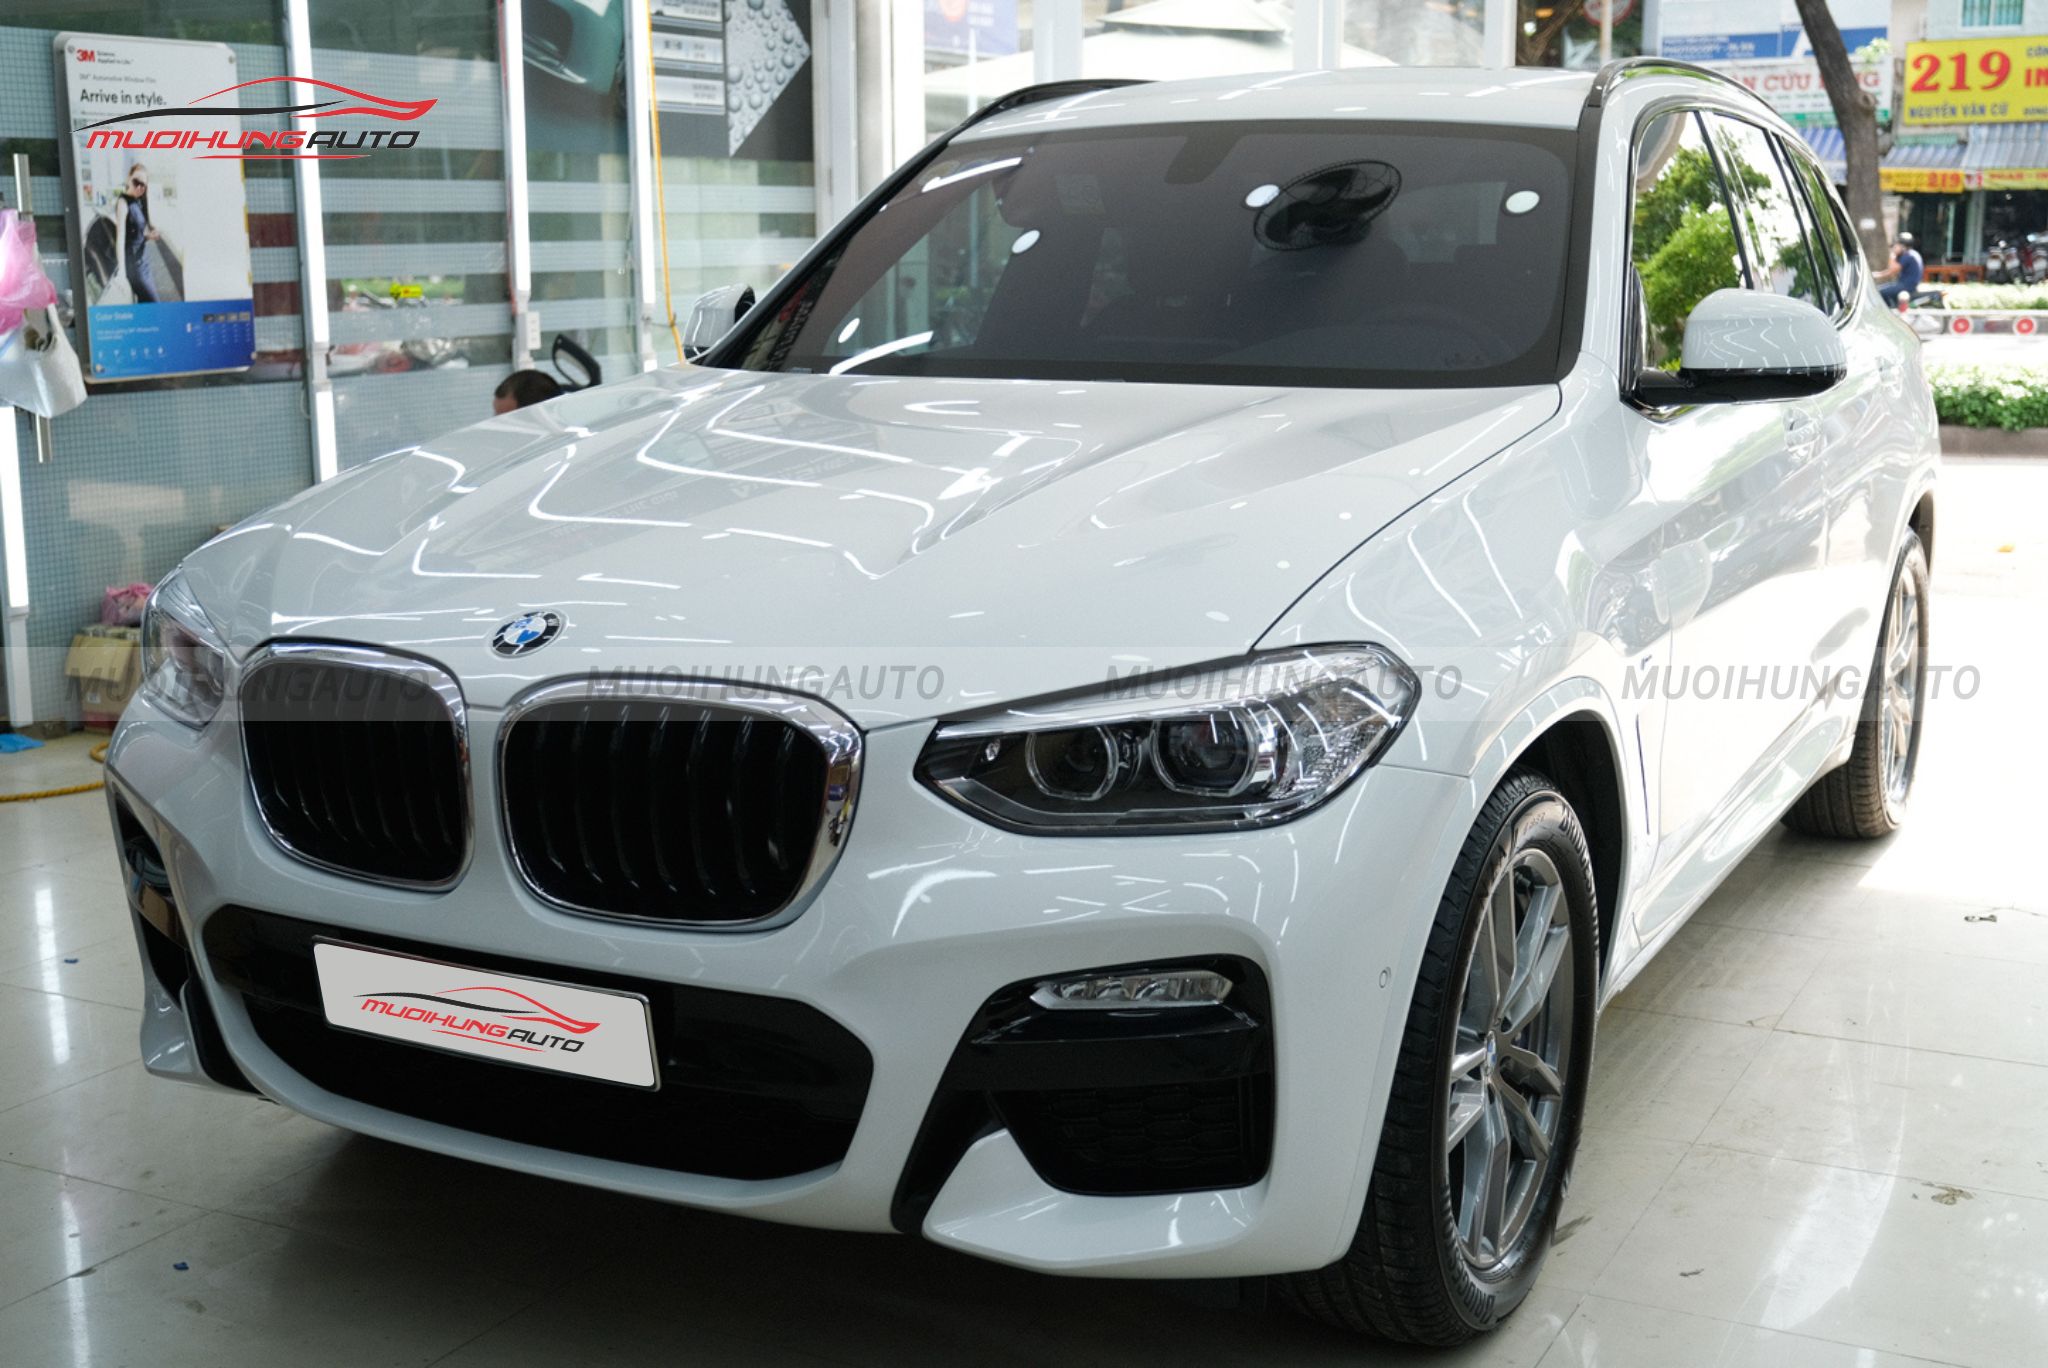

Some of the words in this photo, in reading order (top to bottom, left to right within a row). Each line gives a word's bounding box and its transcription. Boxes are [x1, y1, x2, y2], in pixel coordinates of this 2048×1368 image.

[76, 49, 96, 63] 3M
[1910, 48, 2012, 93] 219
[80, 88, 118, 103] Arrive
[121, 90, 132, 104] in
[135, 91, 167, 107] style.
